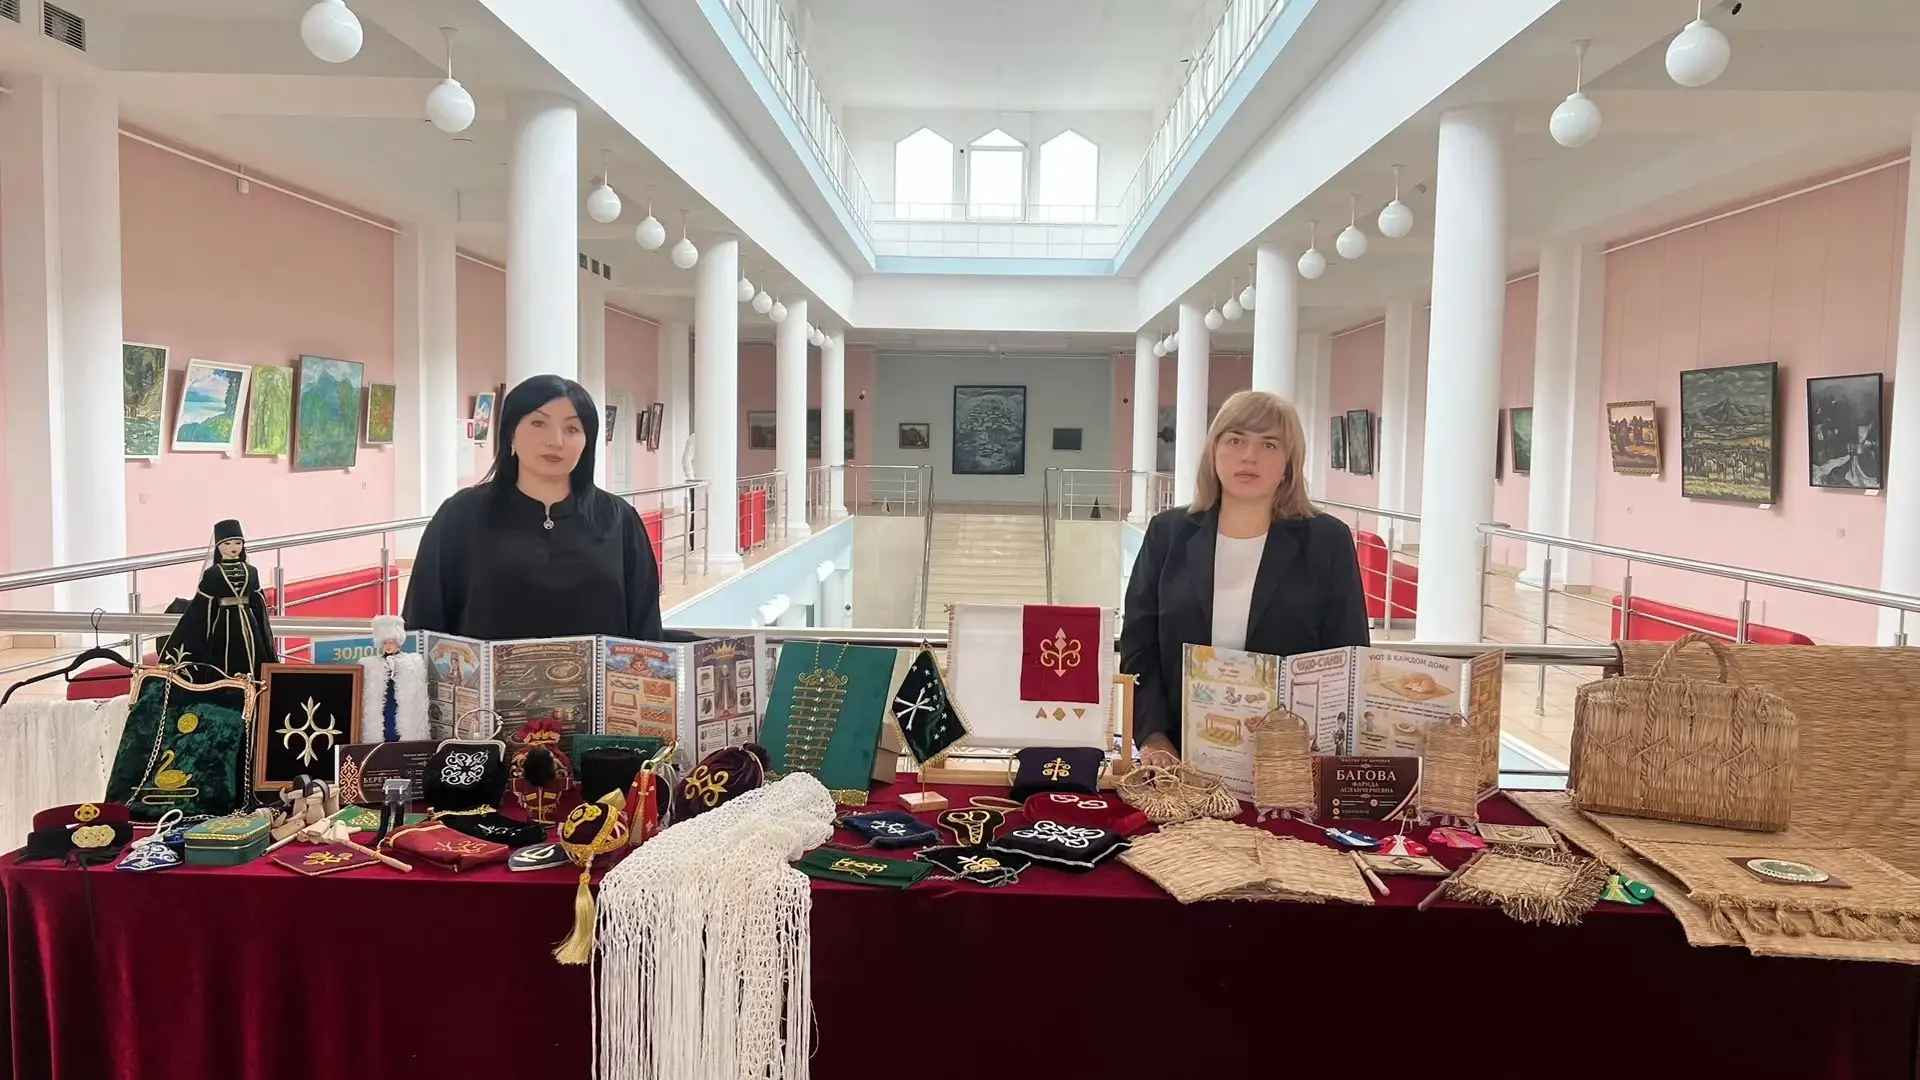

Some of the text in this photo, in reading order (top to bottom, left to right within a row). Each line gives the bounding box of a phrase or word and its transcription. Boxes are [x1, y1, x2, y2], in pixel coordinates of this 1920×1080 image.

[1394, 655, 1426, 665] КАЖДОМ
[1427, 660, 1449, 672] ДОМЕ
[1336, 769, 1397, 781] БАГОВА
